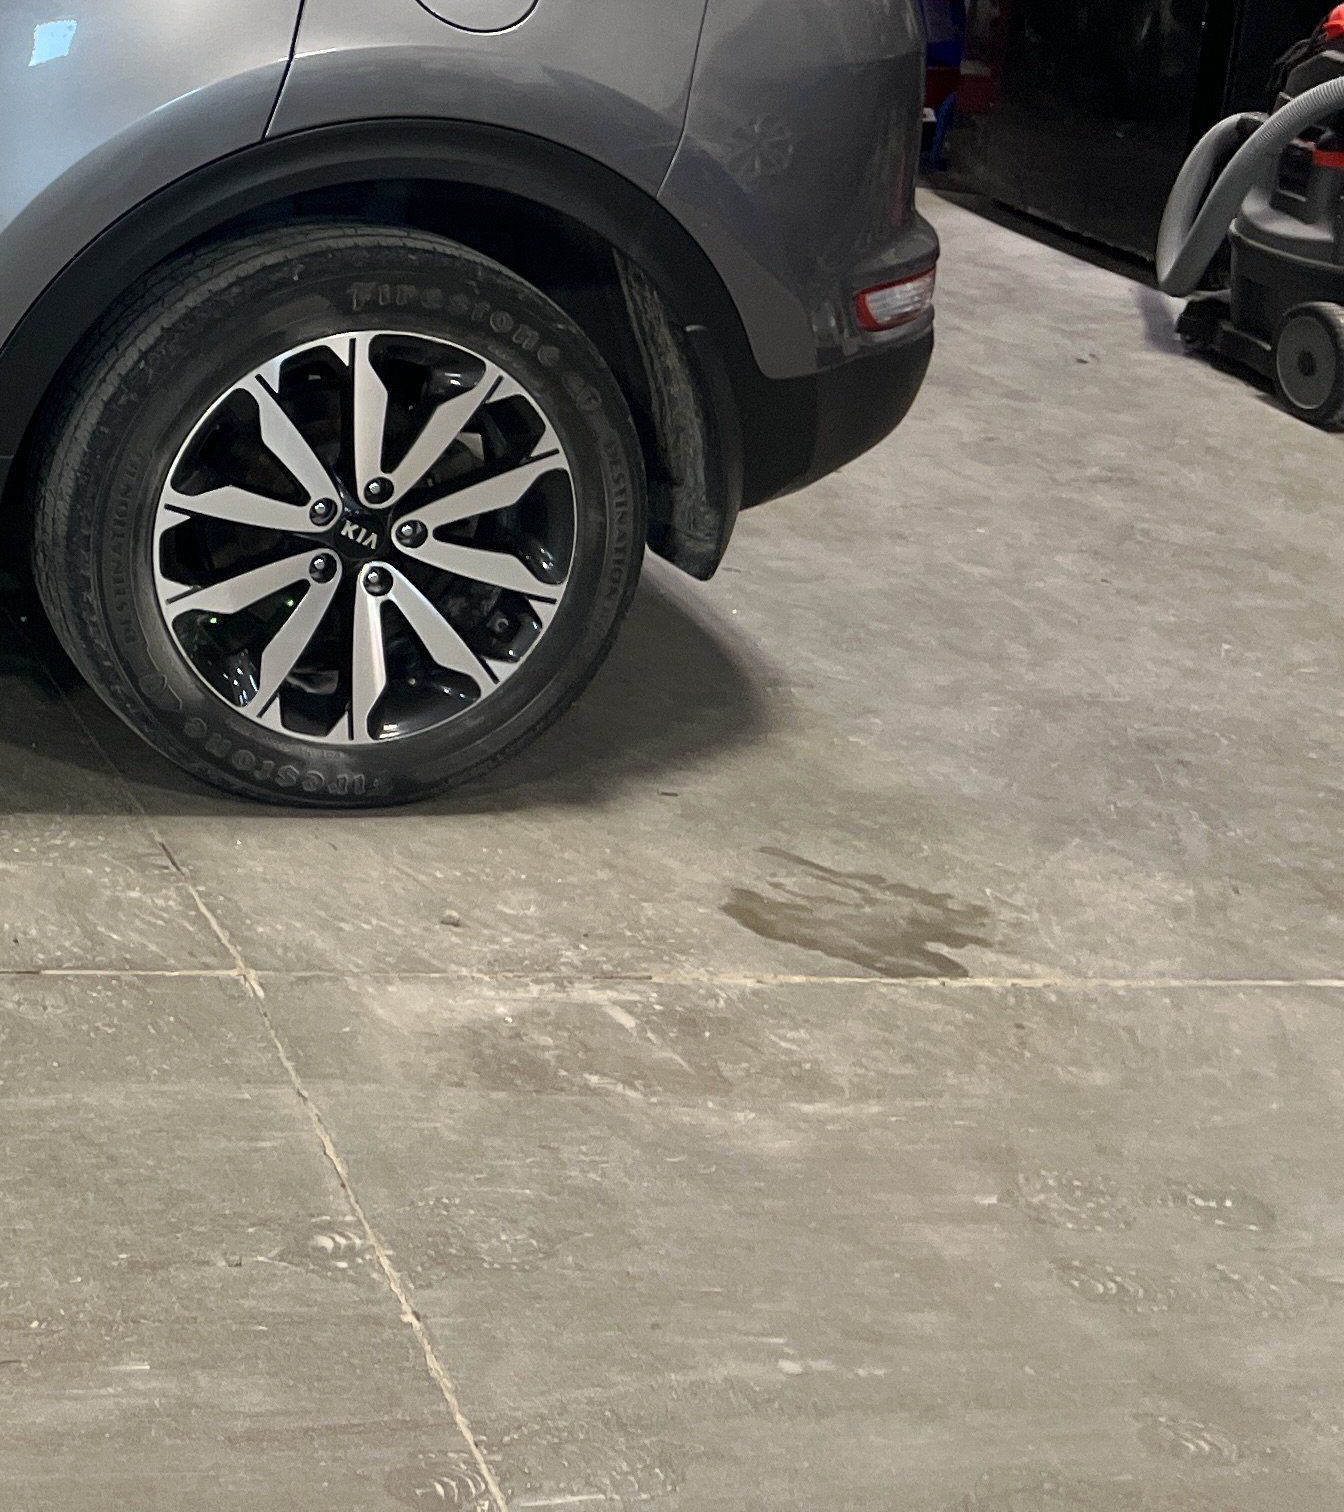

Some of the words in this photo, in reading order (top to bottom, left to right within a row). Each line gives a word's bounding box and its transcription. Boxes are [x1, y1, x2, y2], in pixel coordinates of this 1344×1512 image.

[347, 282, 561, 368] Firestone
[341, 519, 378, 550] KIA
[184, 717, 380, 796] irestone
